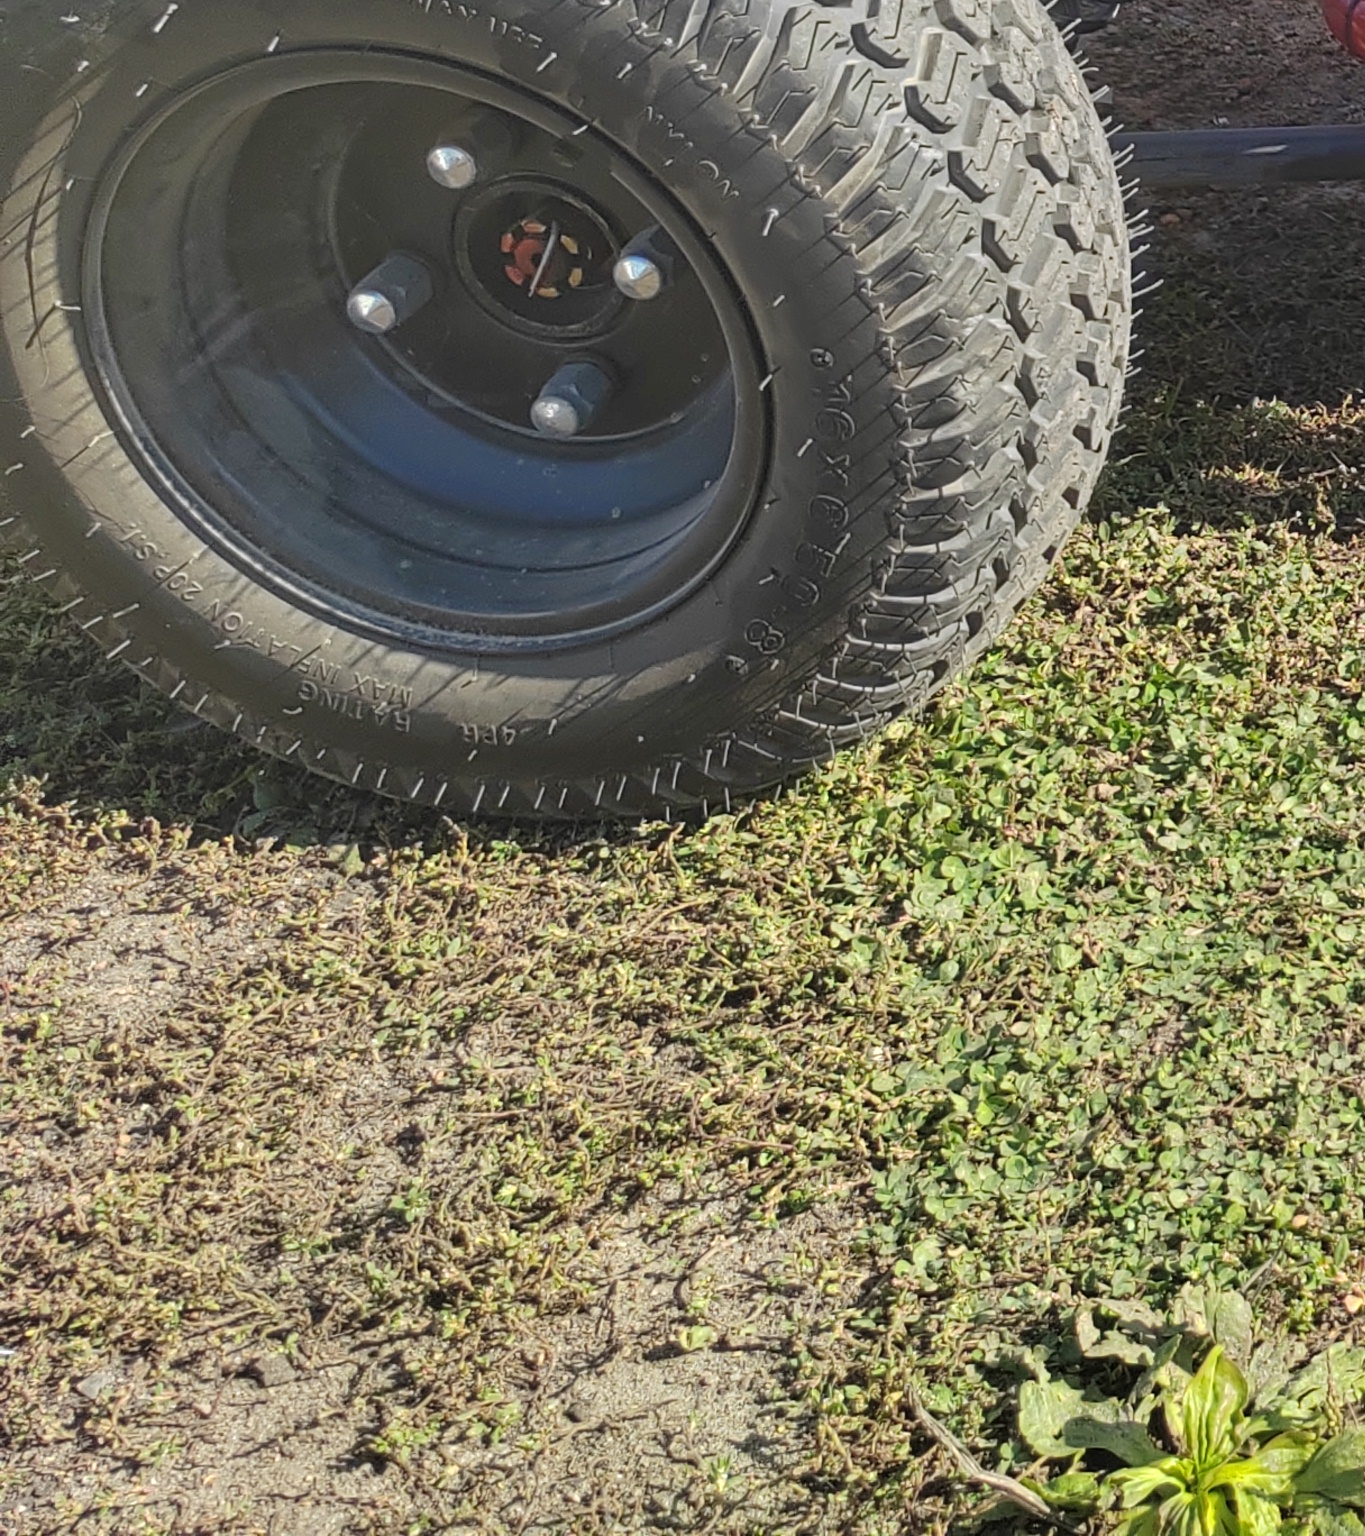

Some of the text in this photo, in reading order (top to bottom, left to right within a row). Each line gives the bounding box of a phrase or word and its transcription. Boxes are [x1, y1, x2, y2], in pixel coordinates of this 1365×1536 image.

[488, 14, 545, 51] USE
[206, 598, 342, 686] INFLATION
[352, 671, 414, 710] MAX
